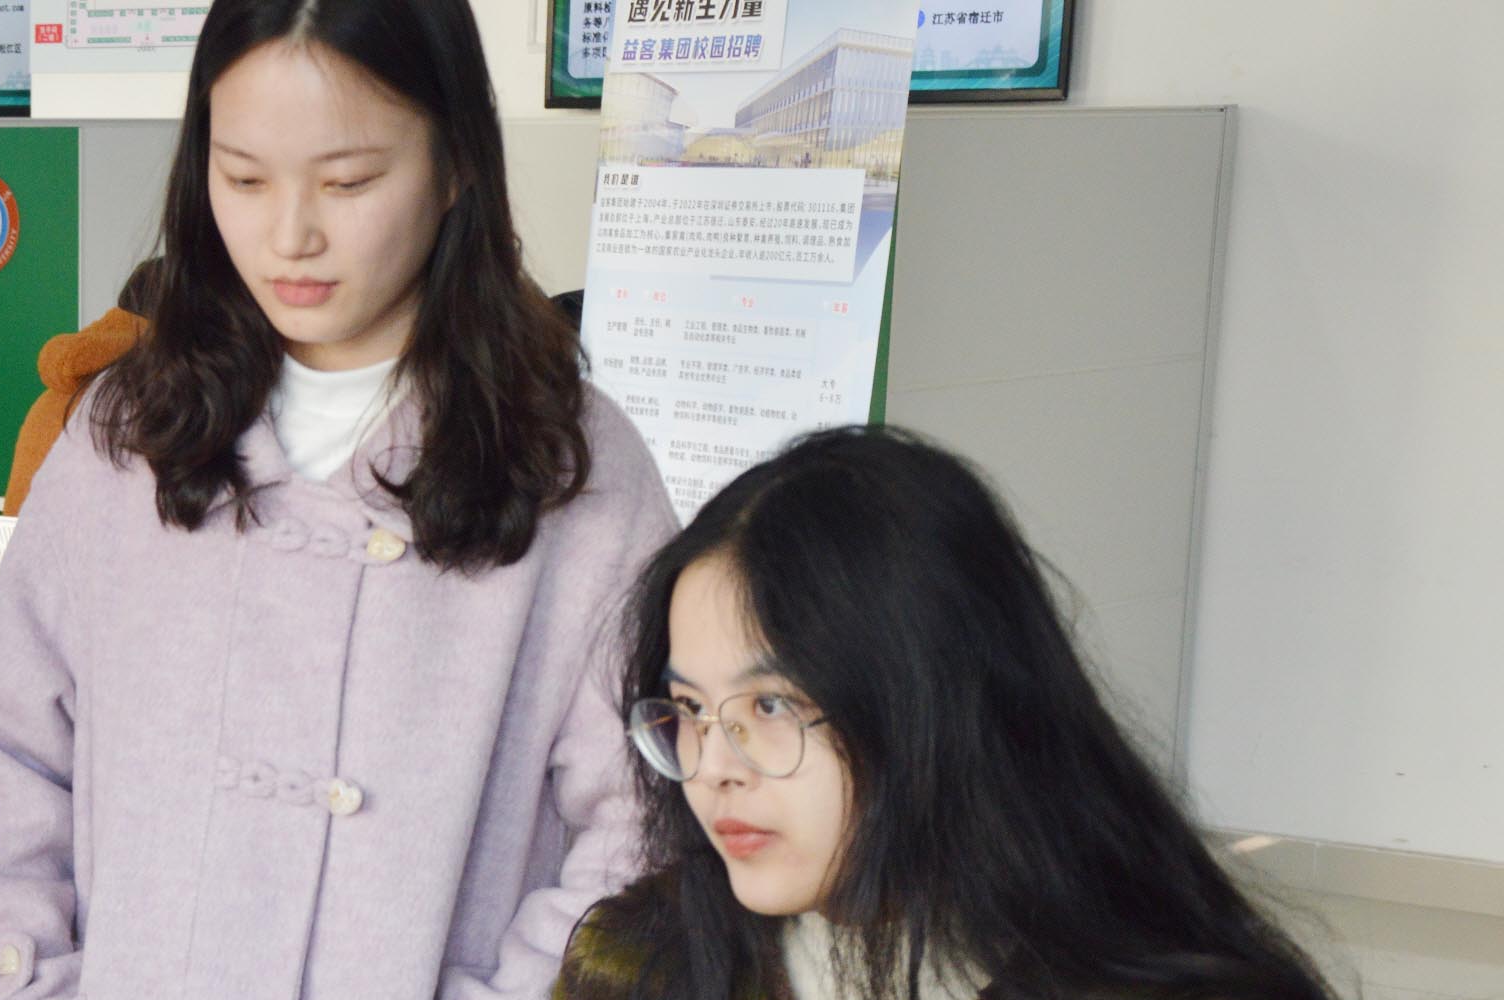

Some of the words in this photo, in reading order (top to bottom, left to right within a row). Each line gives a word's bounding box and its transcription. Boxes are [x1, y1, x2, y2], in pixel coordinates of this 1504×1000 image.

[584, 17, 609, 29] 务等
[932, 10, 1004, 25] 江苏省宿迁市
[622, 33, 763, 61] 益客集团校园招聘
[603, 173, 640, 186] 我们是谁
